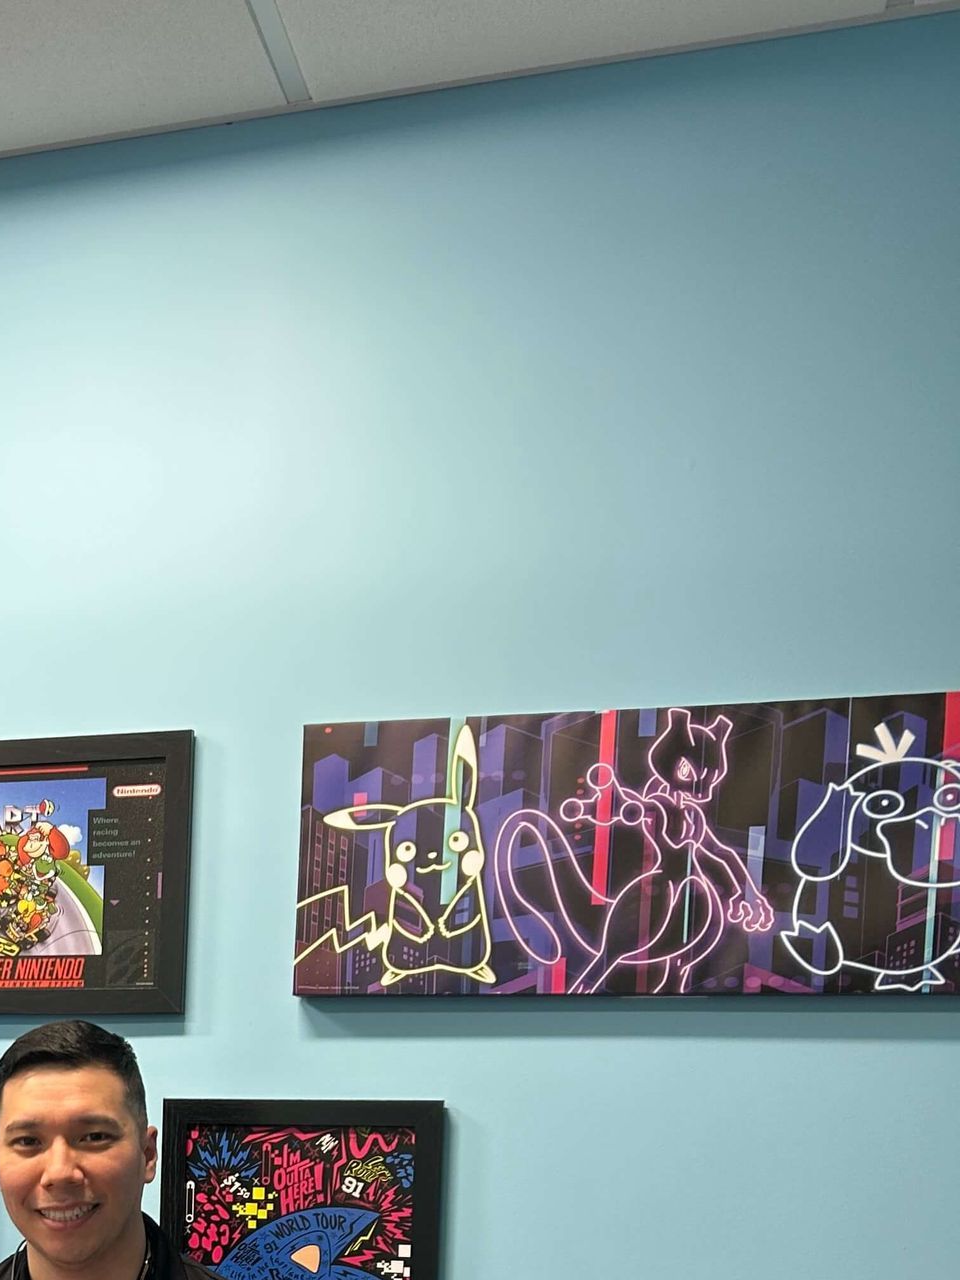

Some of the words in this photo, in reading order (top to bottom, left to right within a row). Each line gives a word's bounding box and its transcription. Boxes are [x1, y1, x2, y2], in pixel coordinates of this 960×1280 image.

[115, 787, 159, 795] Nintendo
[93, 829, 118, 837] racing
[93, 851, 136, 859] adventure!
[15, 958, 84, 979] NINTENDO
[273, 1160, 315, 1191] OUTTA
[342, 1176, 364, 1198] 91
[269, 1214, 311, 1239] WORLD
[313, 1212, 348, 1231] TOUR
[264, 1241, 279, 1254] 91
